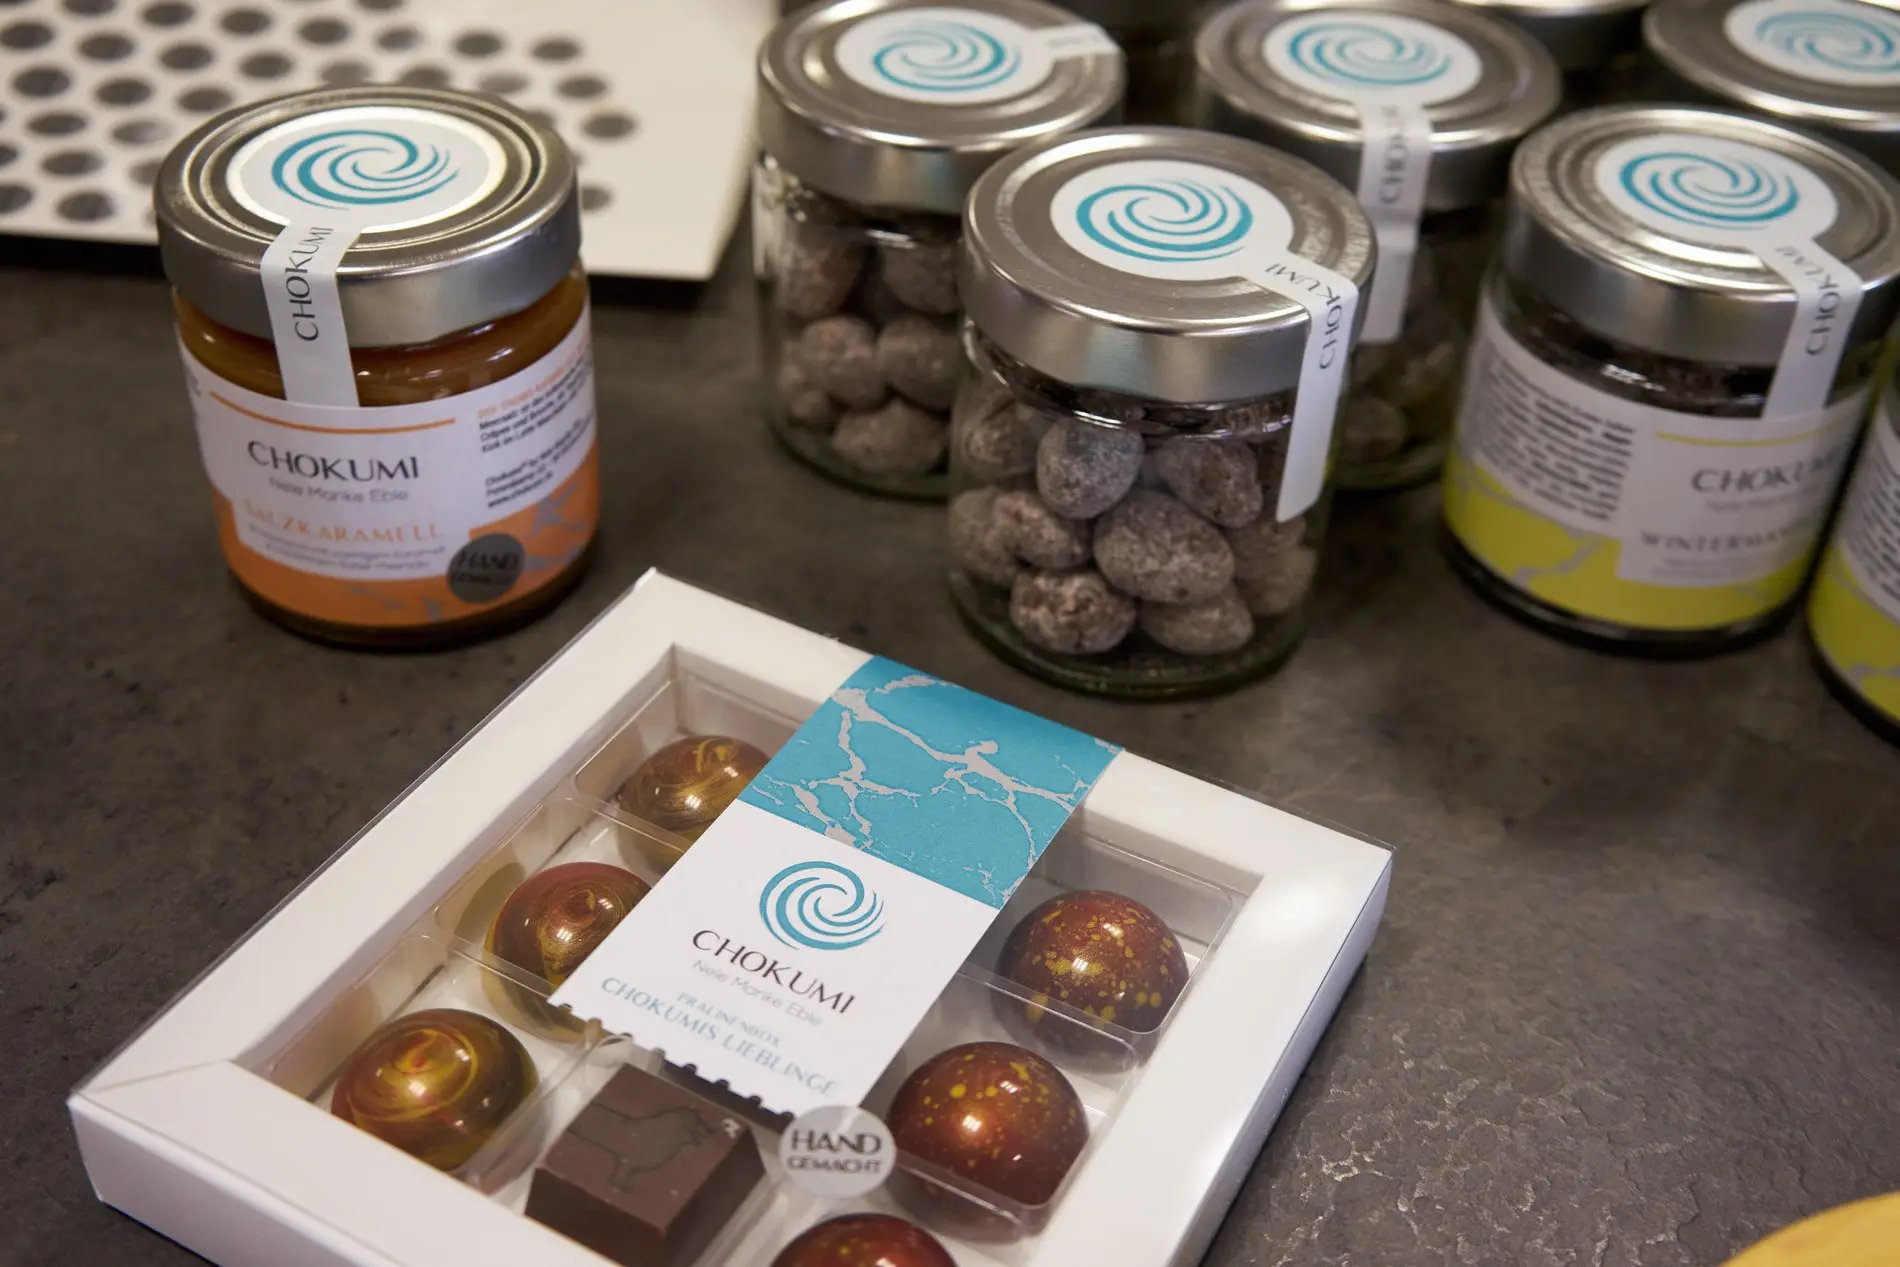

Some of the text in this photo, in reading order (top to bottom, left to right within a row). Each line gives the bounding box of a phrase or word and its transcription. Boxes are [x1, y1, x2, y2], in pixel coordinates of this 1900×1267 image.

[284, 226, 334, 342] CHOKUMI
[1264, 263, 1343, 370] CHOKUMI
[247, 439, 421, 482] CHOKUMI
[692, 929, 856, 1014] CHOKUMI
[600, 976, 839, 1097] CHOKUMIS LIEBLINGE
[790, 1129, 883, 1156] HAND
